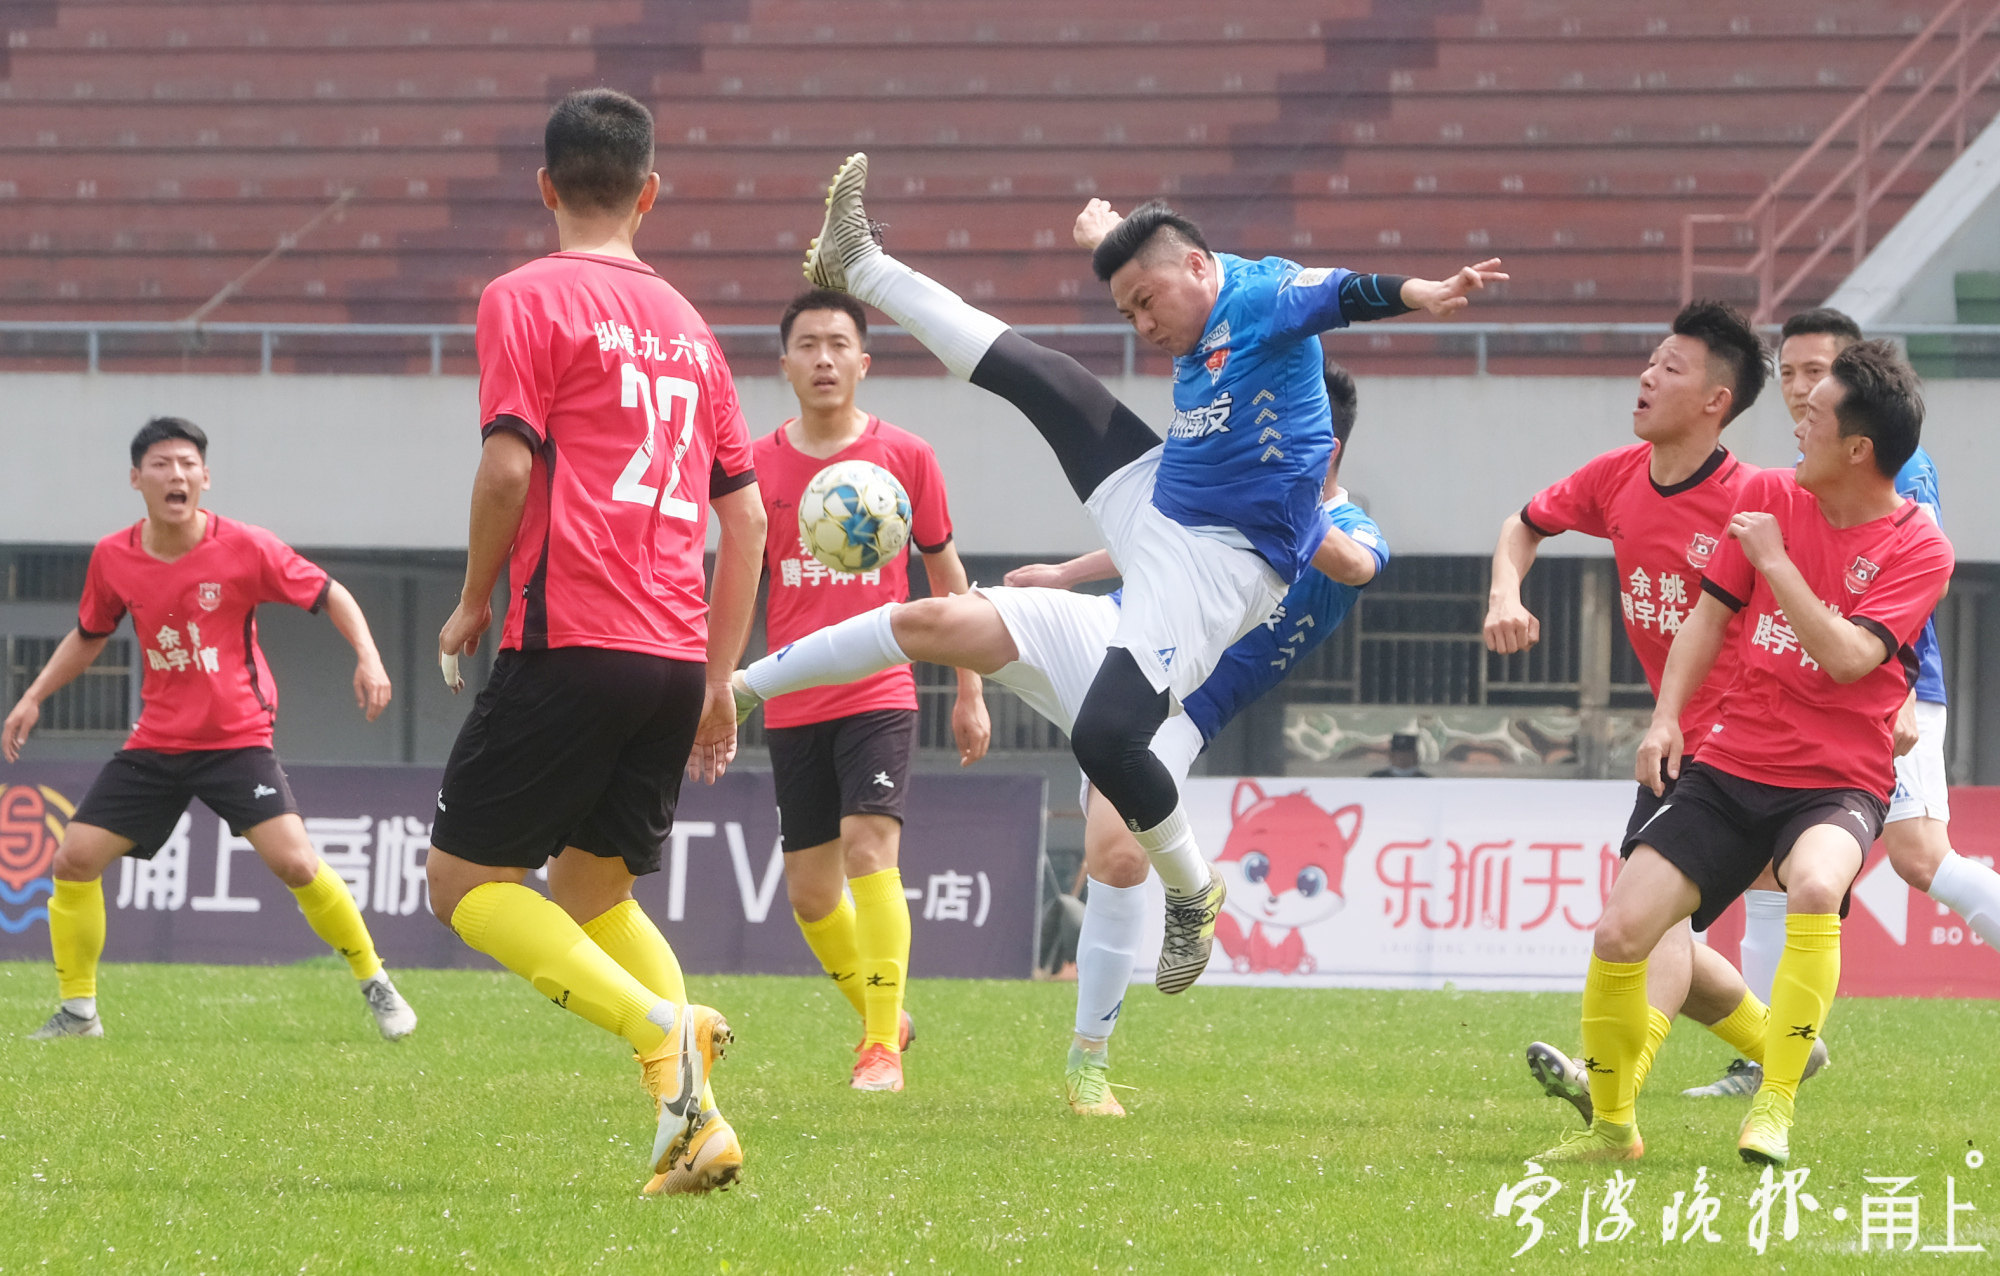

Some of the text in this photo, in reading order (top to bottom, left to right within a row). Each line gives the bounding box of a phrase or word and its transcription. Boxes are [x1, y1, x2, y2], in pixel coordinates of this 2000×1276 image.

[611, 362, 699, 523] 22
[1629, 566, 1688, 604] 余姚
[1620, 590, 1695, 635] 腾宇体
